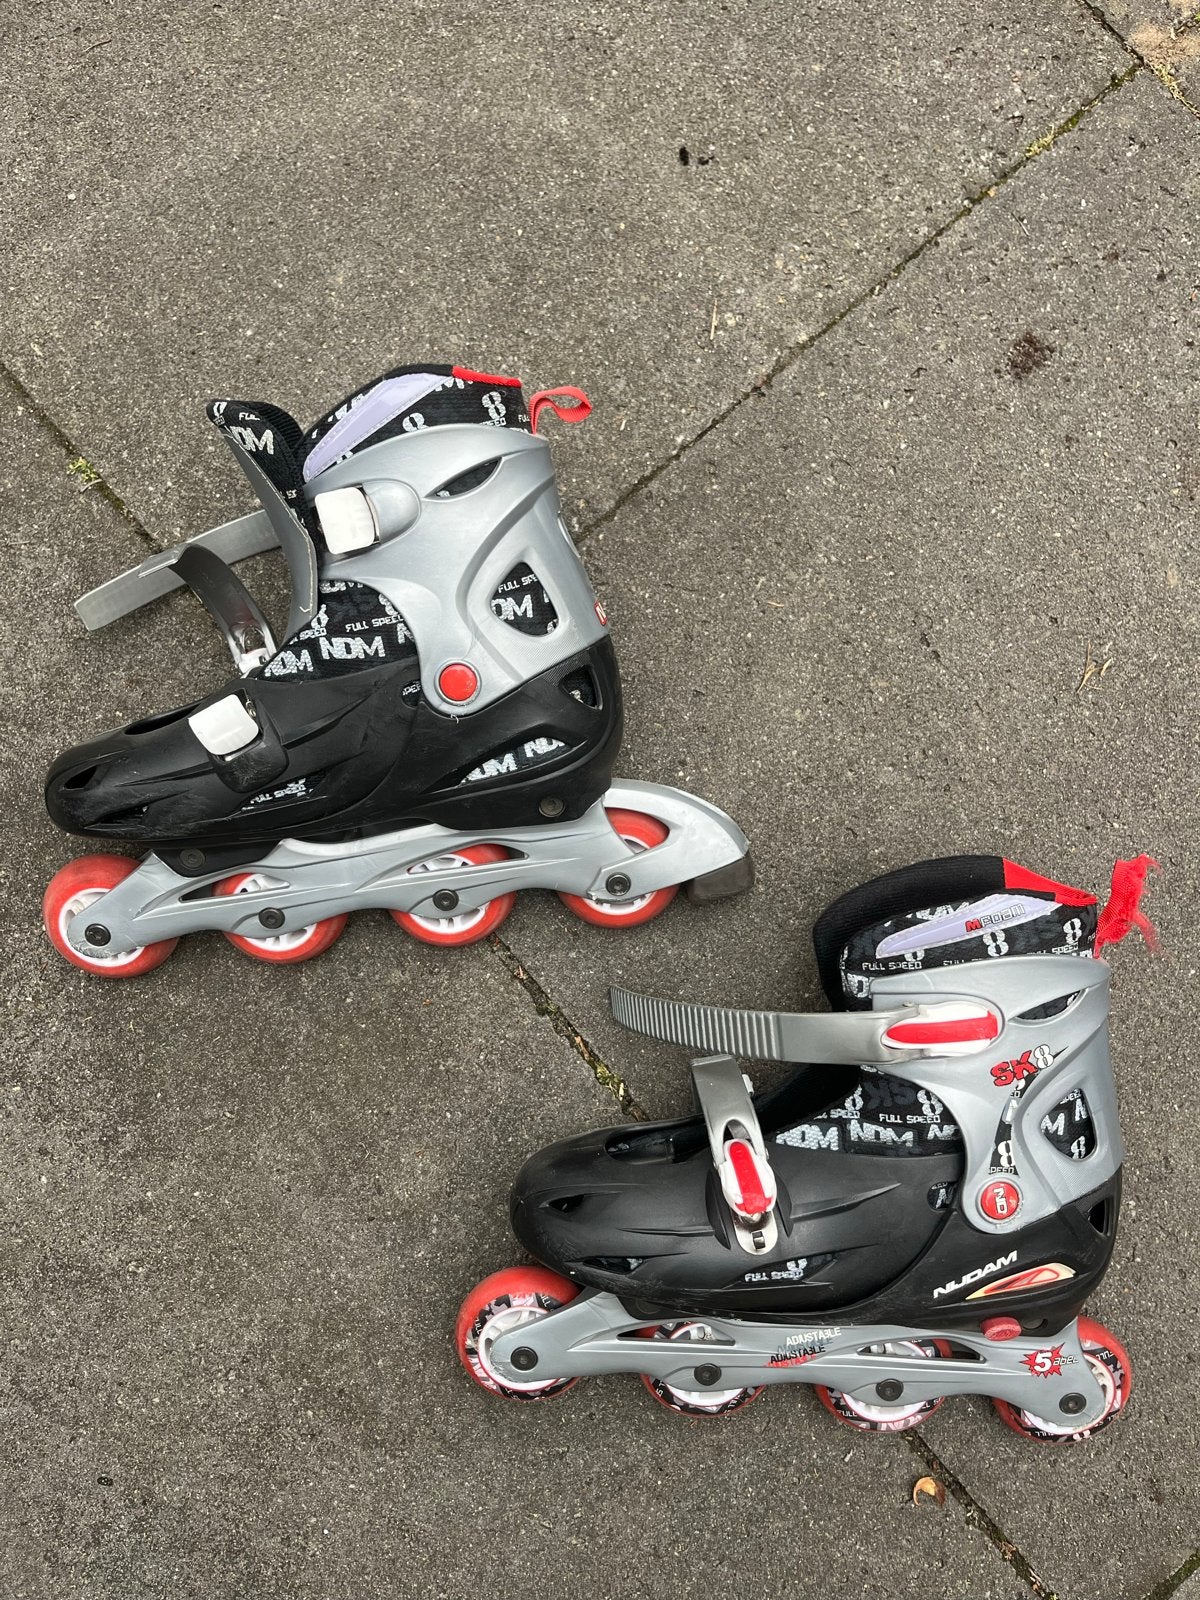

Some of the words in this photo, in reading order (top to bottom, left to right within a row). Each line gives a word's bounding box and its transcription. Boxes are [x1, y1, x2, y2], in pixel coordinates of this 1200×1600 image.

[482, 391, 507, 420] 8
[498, 580, 520, 593] FULL
[345, 620, 370, 633] FULL
[319, 636, 386, 660] NDM
[982, 928, 1010, 957] 8
[1063, 917, 1082, 945] 8
[861, 962, 886, 971] FULL
[990, 1044, 1055, 1087] SK8
[879, 1113, 903, 1124] FULL
[906, 1114, 941, 1124] SPEED
[850, 1119, 914, 1147] NDM
[786, 1327, 842, 1346] ADJUSTABLE
